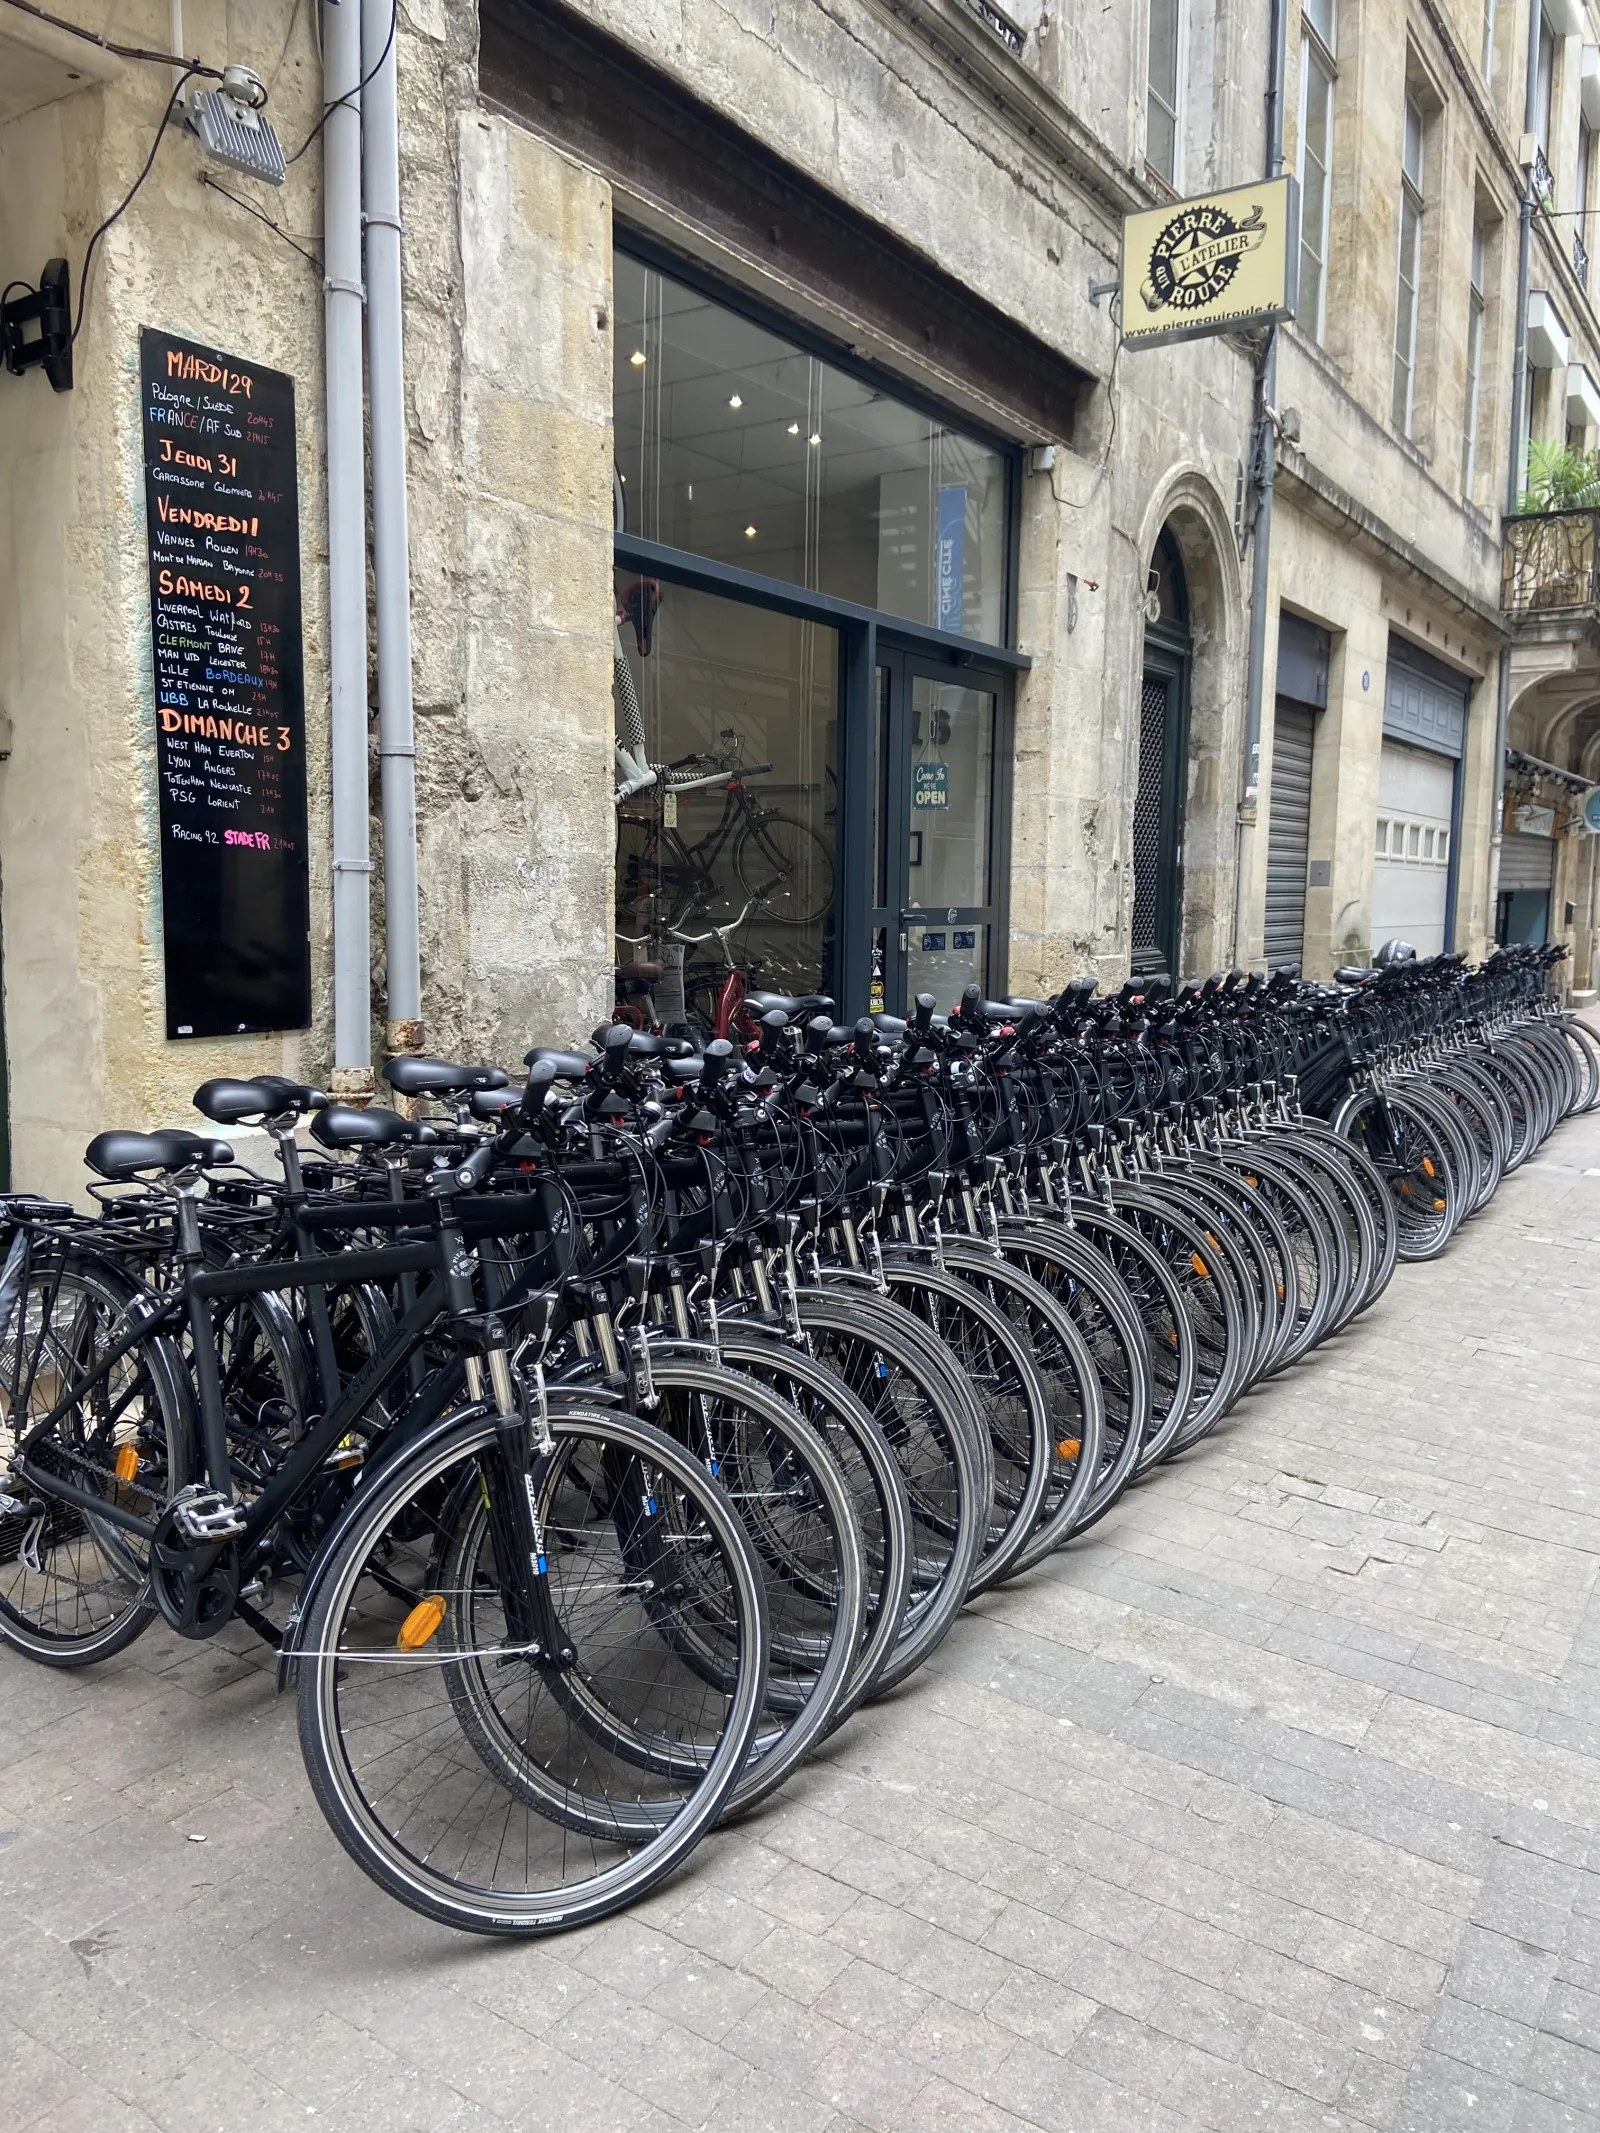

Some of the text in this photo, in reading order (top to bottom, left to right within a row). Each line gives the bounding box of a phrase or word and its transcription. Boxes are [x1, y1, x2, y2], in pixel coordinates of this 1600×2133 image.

[1155, 211, 1227, 259] PIERRE
[1179, 234, 1250, 273] L'ATELIER
[1155, 265, 1171, 290] QUI
[1168, 264, 1233, 305] ROULE
[166, 351, 253, 400] MARDI 29
[247, 412, 275, 429] 20H45
[159, 439, 238, 478] JEUDI 31
[157, 494, 249, 535] VENDREDI
[156, 530, 196, 549] VANNES
[186, 554, 214, 568] MARSAN
[158, 569, 254, 610] SAMEDI 2
[157, 598, 204, 619] LIVERPOOL
[156, 613, 198, 634] CASTRES
[158, 633, 213, 651] CLERMONT
[260, 650, 276, 662] 17H
[158, 648, 180, 660] MAN
[160, 662, 278, 690] LILLE BORDEAUX 19H
[160, 678, 175, 688] ST
[177, 680, 214, 694] ETIENNE
[221, 687, 236, 696] OM
[160, 691, 189, 706] UBB
[198, 697, 210, 710] LA
[157, 708, 292, 752] DIMANCHE 3
[166, 738, 190, 751] WEST
[194, 741, 212, 756] HAM
[218, 746, 256, 760] EVERTON
[168, 754, 192, 769] LYON
[204, 760, 236, 777] ANGERS
[916, 766, 946, 783] Come In
[169, 788, 198, 804] PSG
[207, 794, 242, 810] LORIENT
[915, 790, 946, 805] OPEN
[171, 824, 204, 843] RACING
[204, 830, 220, 844] 92
[529, 1552, 541, 1575] M3010
